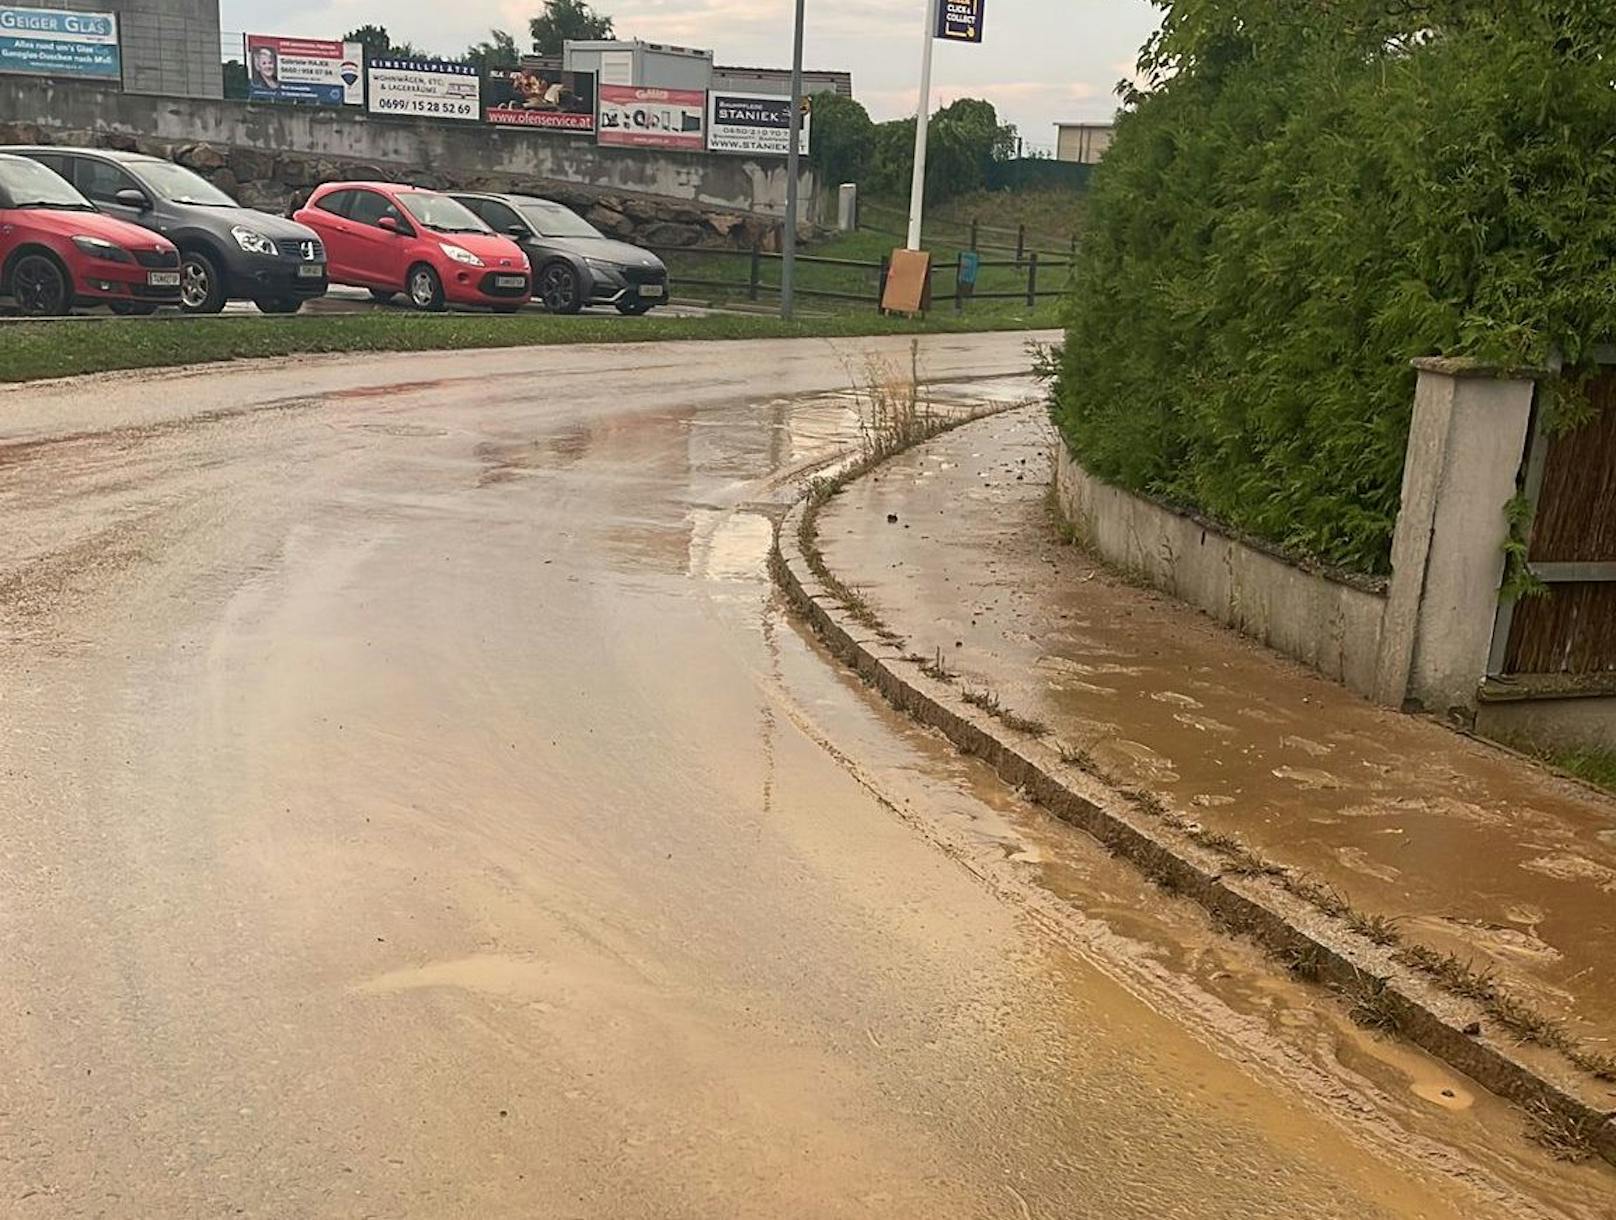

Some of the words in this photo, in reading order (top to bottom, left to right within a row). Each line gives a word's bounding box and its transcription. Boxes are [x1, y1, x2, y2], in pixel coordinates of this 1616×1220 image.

[1, 11, 57, 30] GEIGER
[64, 16, 105, 34] GLAS
[946, 13, 976, 24] COLLECT
[379, 98, 408, 109] 0699/
[413, 101, 424, 110] 15
[427, 102, 439, 112] 28
[443, 103, 455, 113] 52
[458, 104, 471, 114] 69
[719, 109, 779, 122] STANIEK
